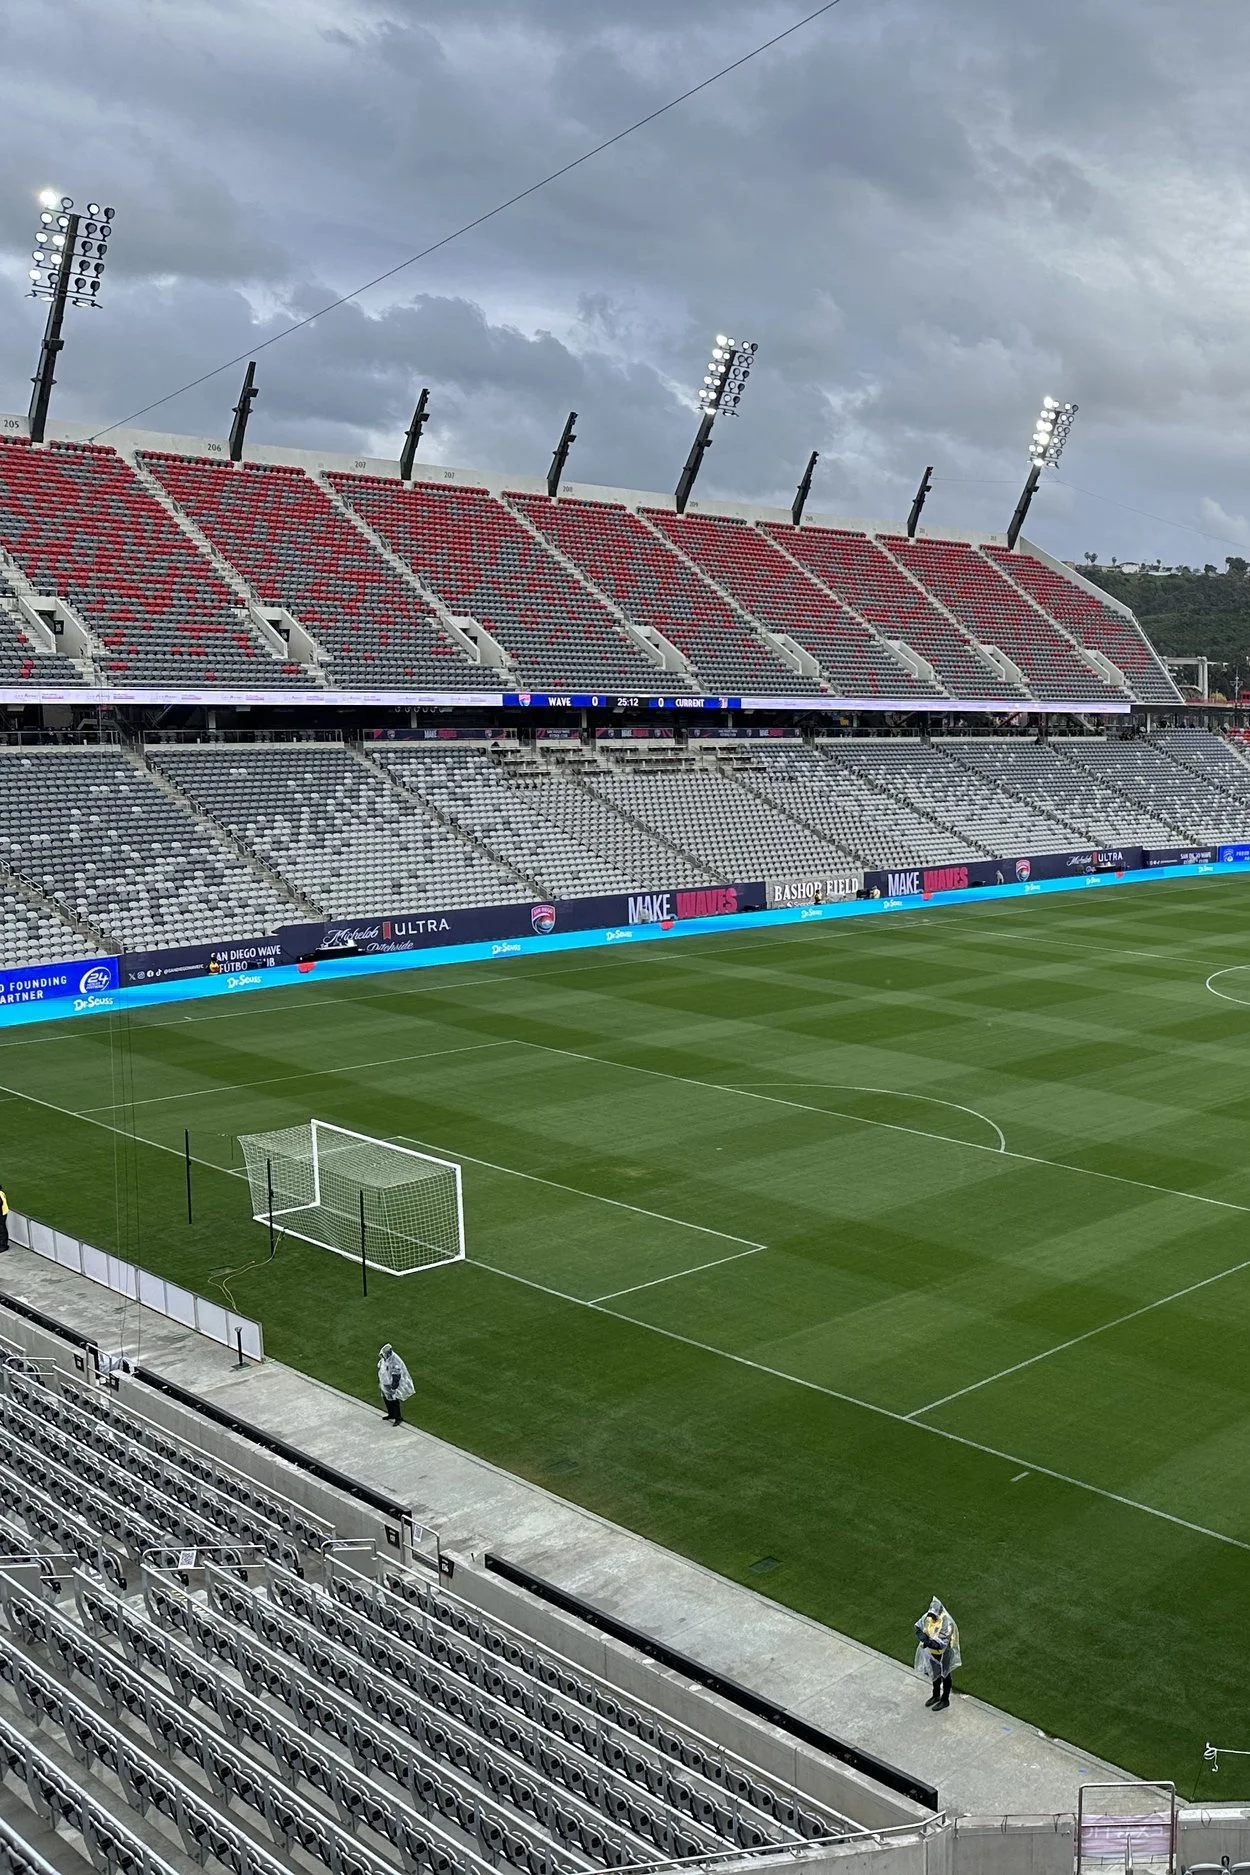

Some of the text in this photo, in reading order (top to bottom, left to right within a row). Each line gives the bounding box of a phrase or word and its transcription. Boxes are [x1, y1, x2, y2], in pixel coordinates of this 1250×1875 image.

[4, 419, 20, 429] 205
[207, 443, 222, 452] 206
[355, 461, 367, 469] 207
[444, 471, 455, 479] 207
[548, 696, 704, 708] WAVE 0 25:12 0 CURRENT
[1098, 851, 1123, 862] ULTRA
[826, 878, 859, 895] FIELD
[888, 867, 968, 896] MAKE WAVES
[628, 888, 737, 924] MAKE WAVES
[323, 918, 449, 944] Michelob ULTRA
[230, 948, 256, 960] DIEGO
[259, 945, 281, 957] WAVE
[219, 960, 248, 973] FÚTBO
[10, 976, 67, 992] FOUNDING
[87, 972, 108, 983] 24
[0, 990, 44, 1004] ARTNER
[88, 995, 114, 1008] Seuss
